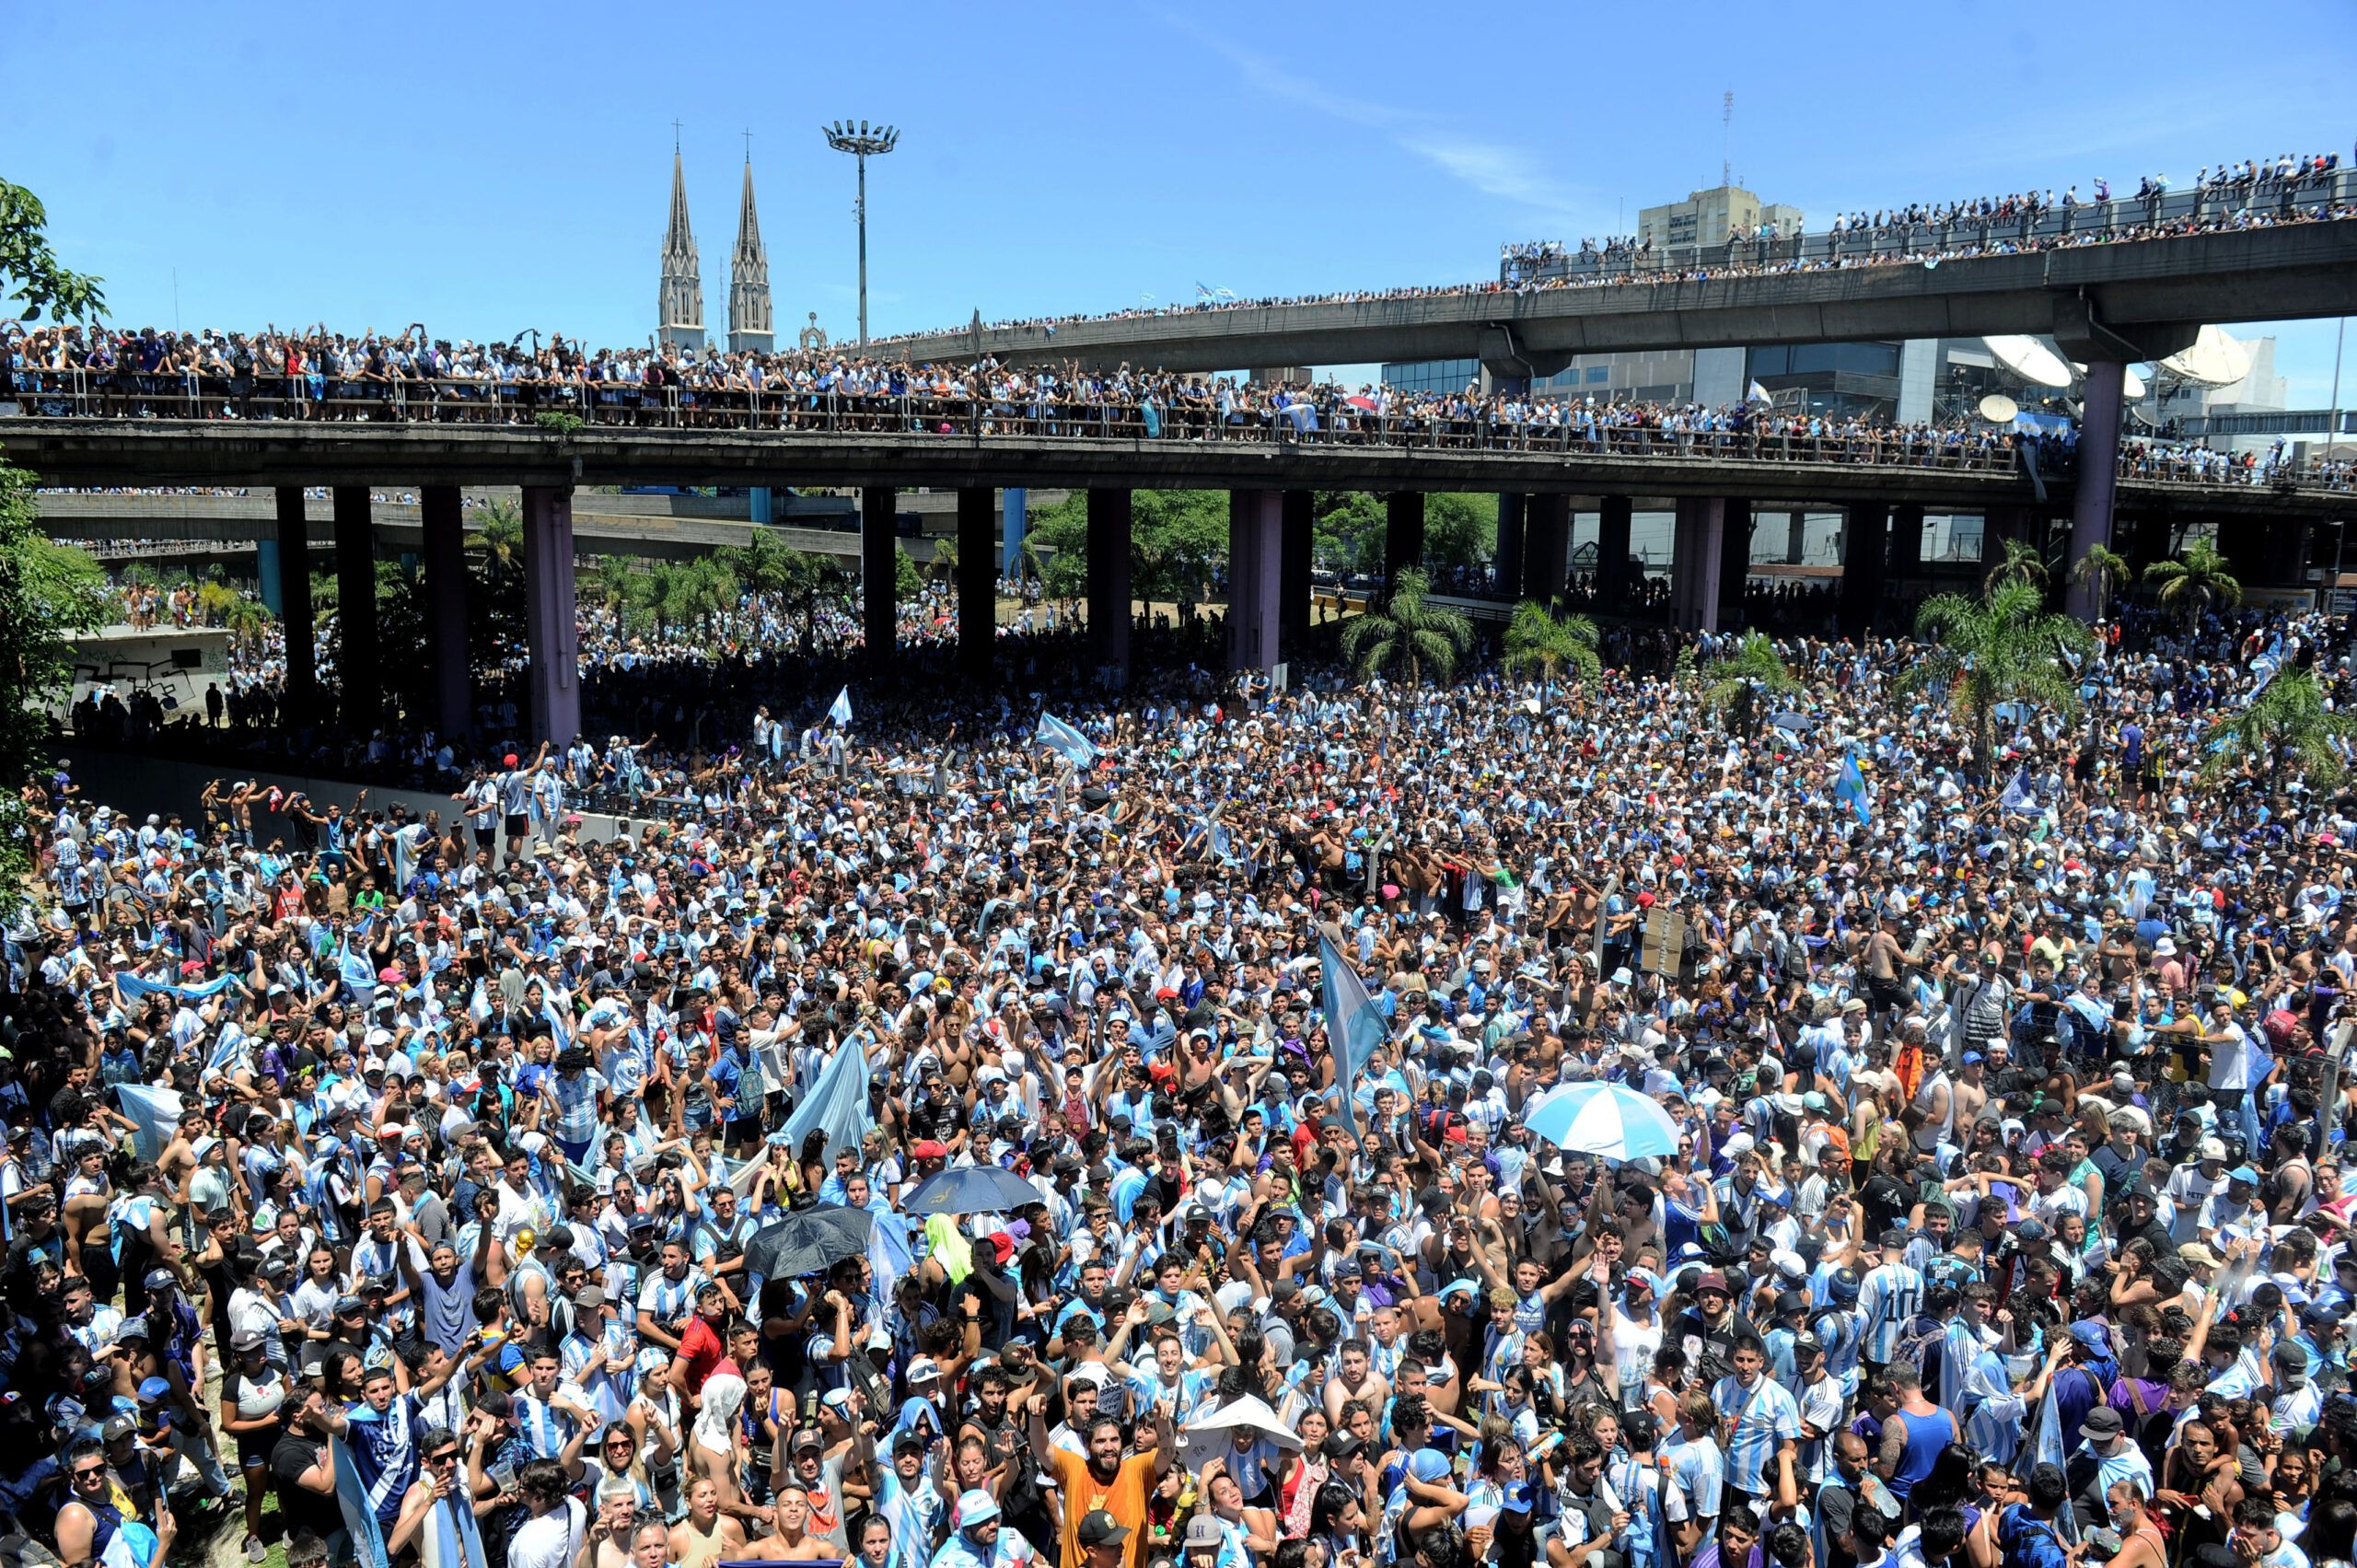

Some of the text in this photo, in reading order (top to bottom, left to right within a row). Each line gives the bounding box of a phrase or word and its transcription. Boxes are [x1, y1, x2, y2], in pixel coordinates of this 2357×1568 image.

[2186, 1191, 2206, 1201] PETR
[1888, 1276, 1913, 1285] MESSI
[1884, 1288, 1917, 1323] 10
[1099, 1385, 1123, 1397] adidas
[1618, 1483, 1644, 1499] MESSI
